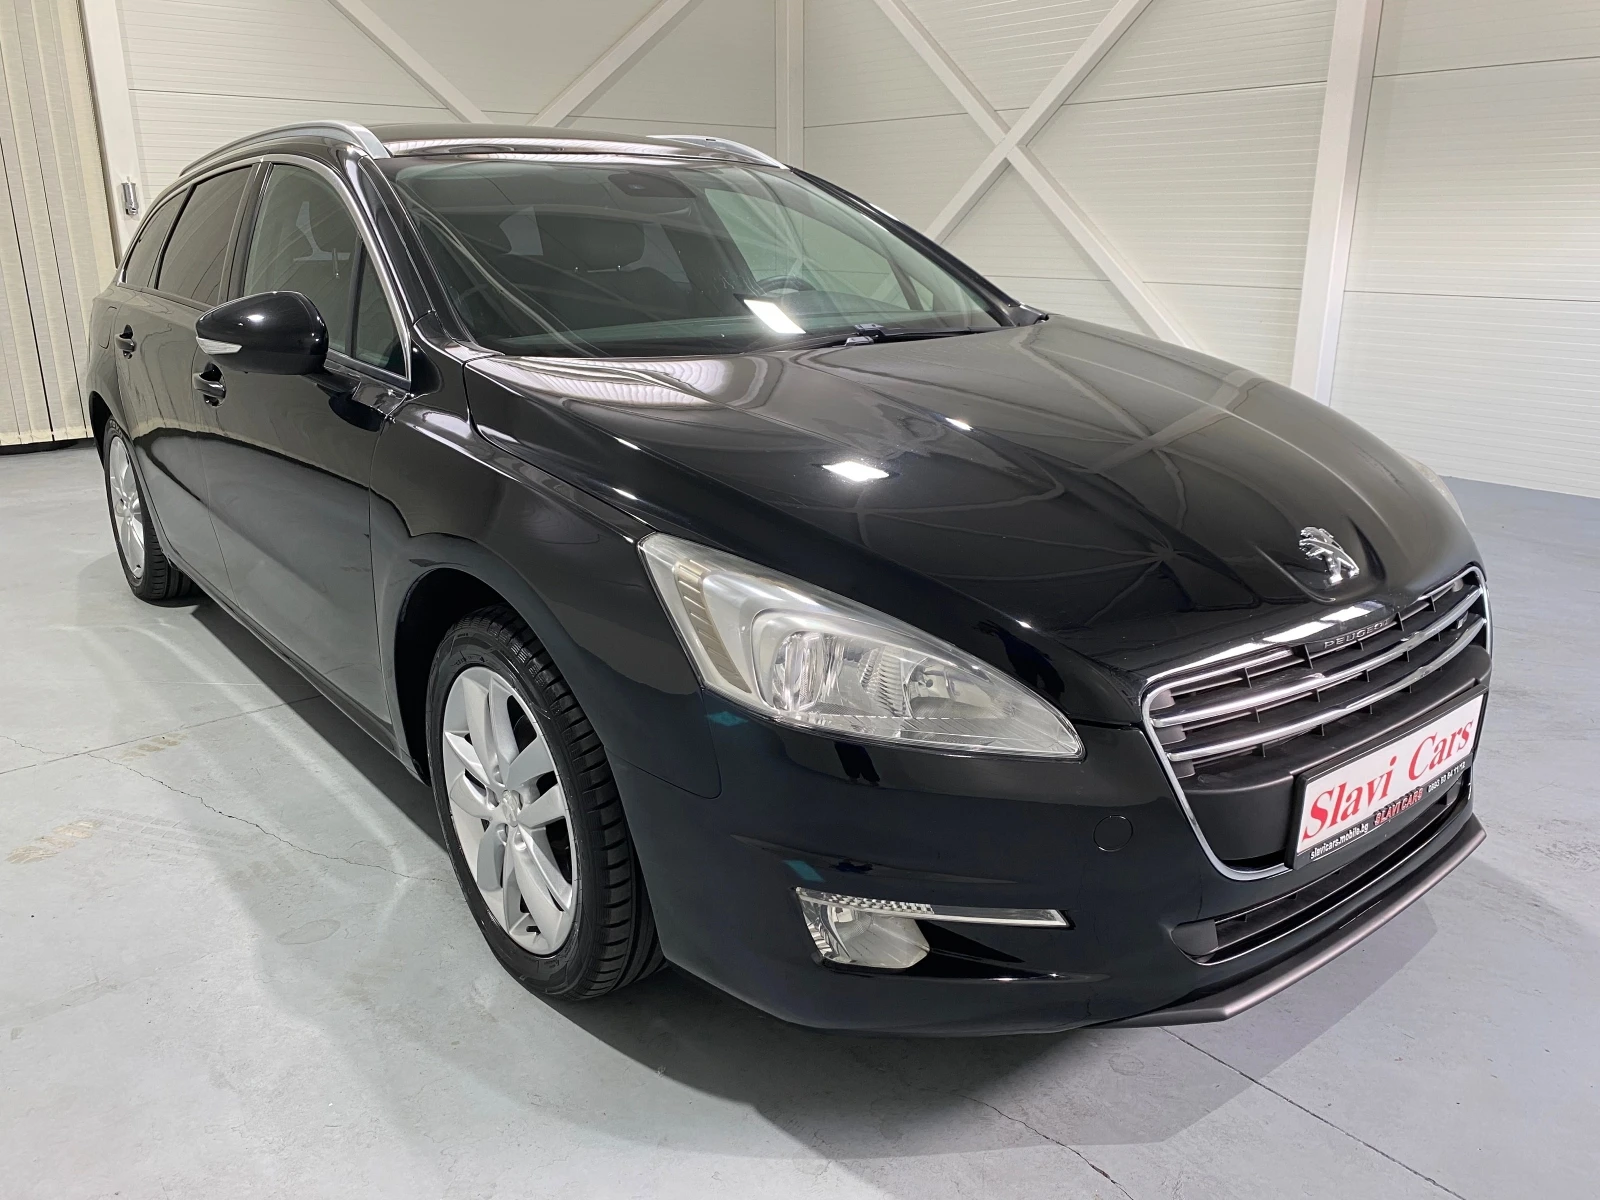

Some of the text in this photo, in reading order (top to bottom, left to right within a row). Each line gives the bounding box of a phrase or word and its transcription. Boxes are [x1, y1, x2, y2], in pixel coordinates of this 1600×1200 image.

[1324, 618, 1389, 648] PEUGEOT
[1302, 720, 1473, 841] Slavi Cars
[1310, 823, 1369, 859] slavicars.mobile.bg
[1374, 802, 1401, 825] SLAVI
[1401, 788, 1423, 811] CARS
